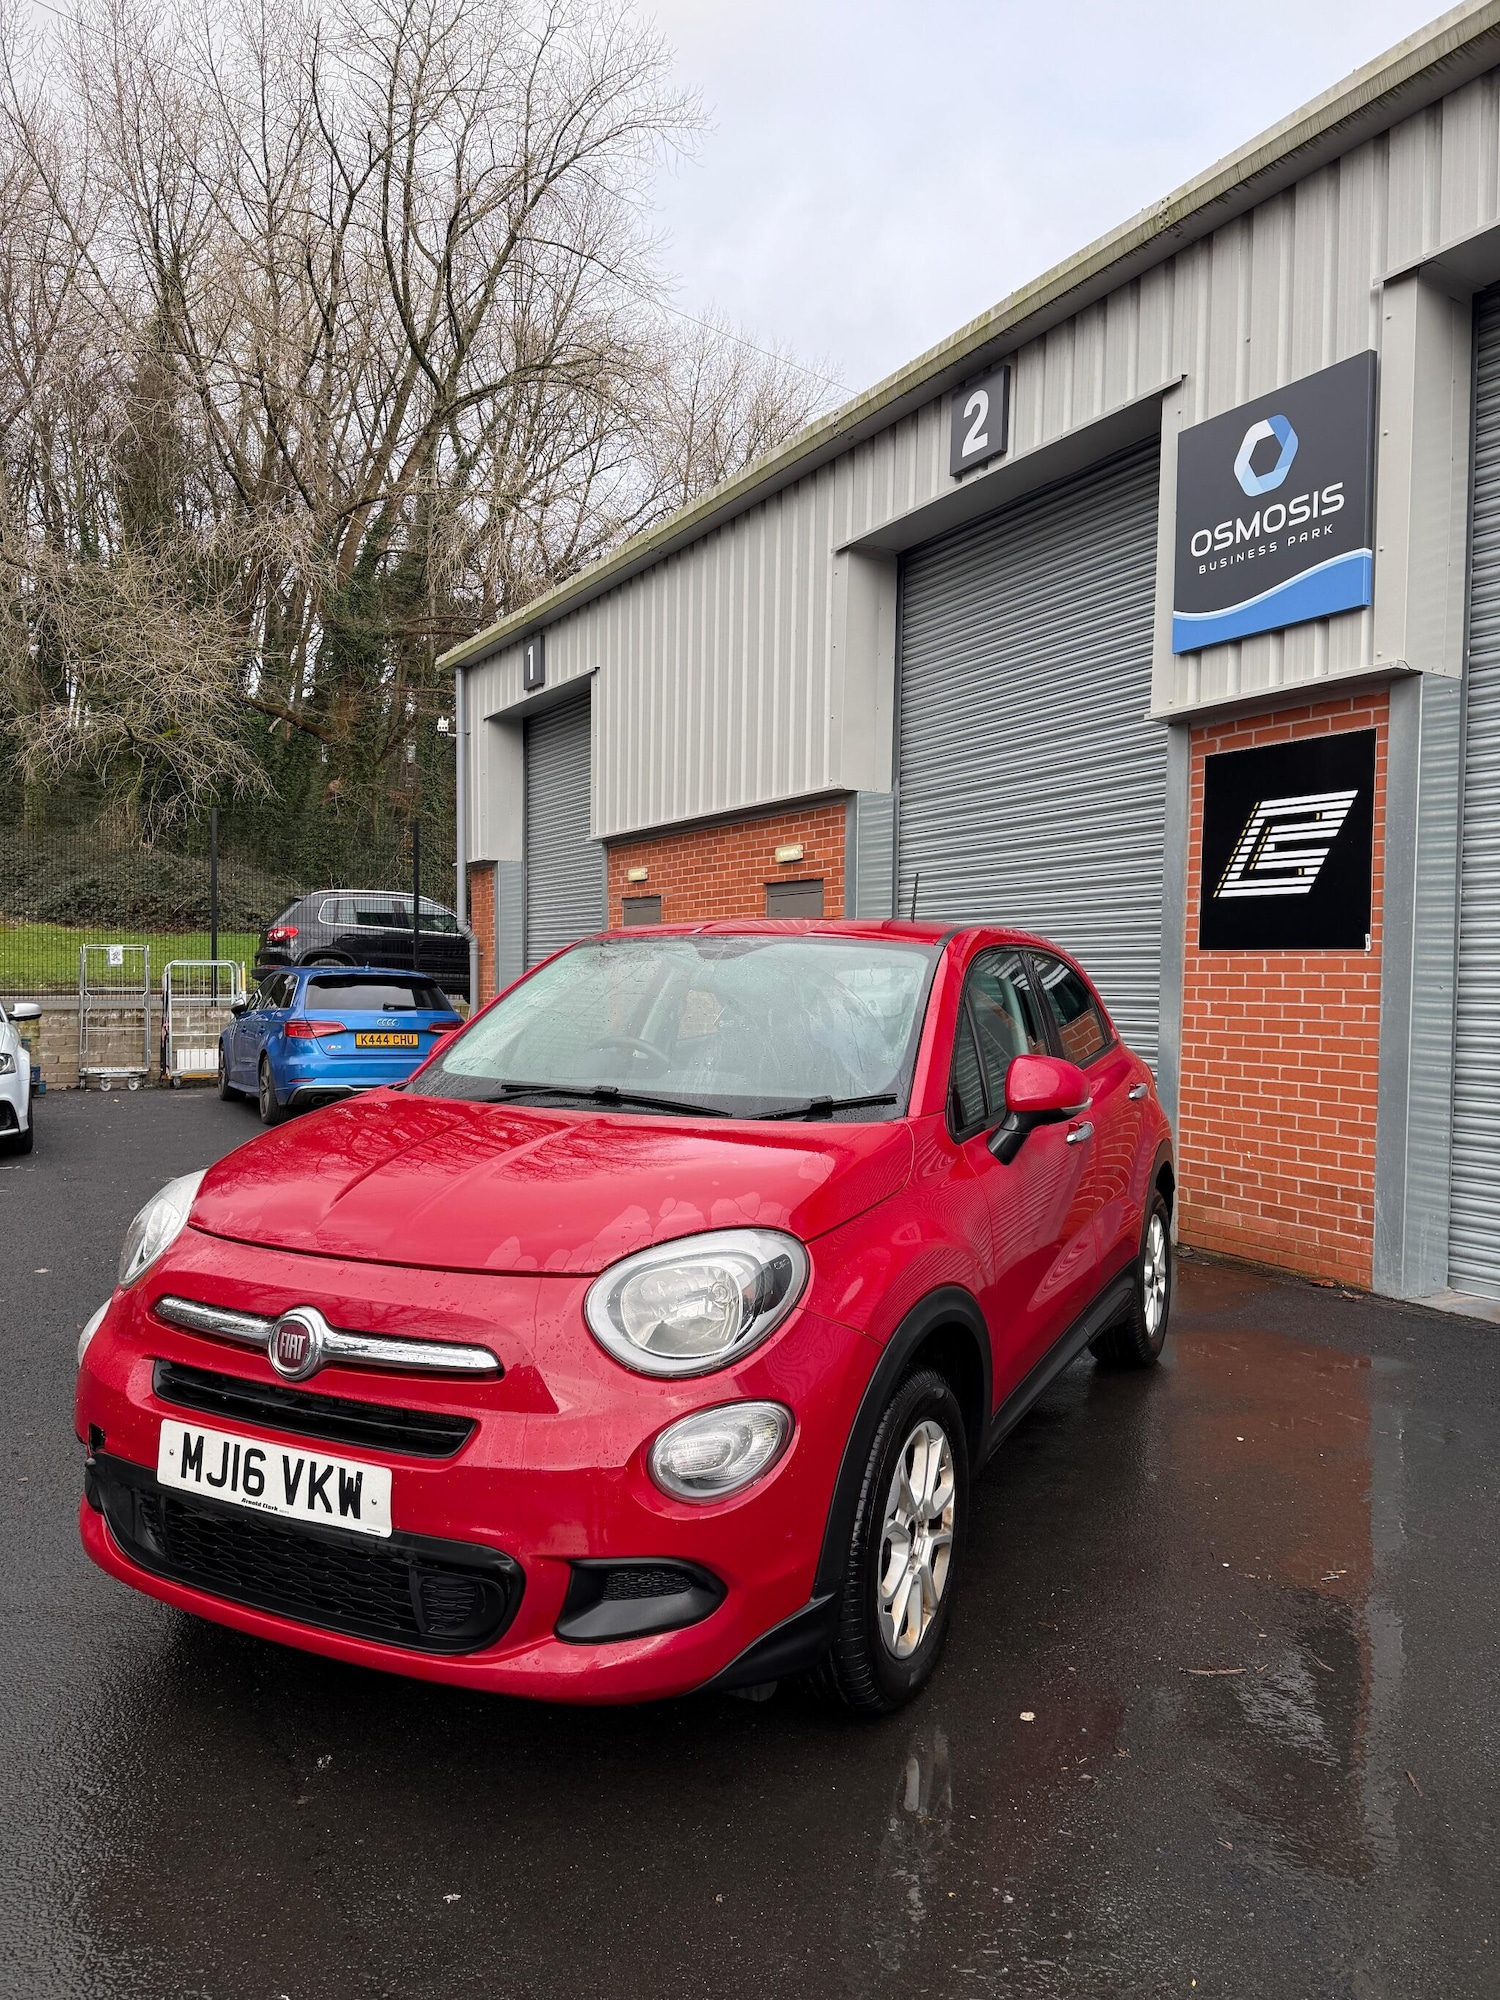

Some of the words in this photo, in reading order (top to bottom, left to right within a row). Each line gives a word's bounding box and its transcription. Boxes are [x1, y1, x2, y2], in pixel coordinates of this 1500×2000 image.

[962, 390, 989, 458] 2
[1190, 481, 1345, 557] OSMOSIS
[1198, 541, 1278, 575] BUSINESS
[1287, 523, 1334, 547] PARK
[527, 645, 534, 680] 1
[360, 1034, 390, 1045] K444
[392, 1034, 414, 1045] CHU
[279, 1331, 307, 1360] FIAT
[180, 1431, 267, 1497] MJ16
[281, 1454, 364, 1520] VKW
[241, 1497, 262, 1507] Arnold
[262, 1502, 279, 1511] Clark
